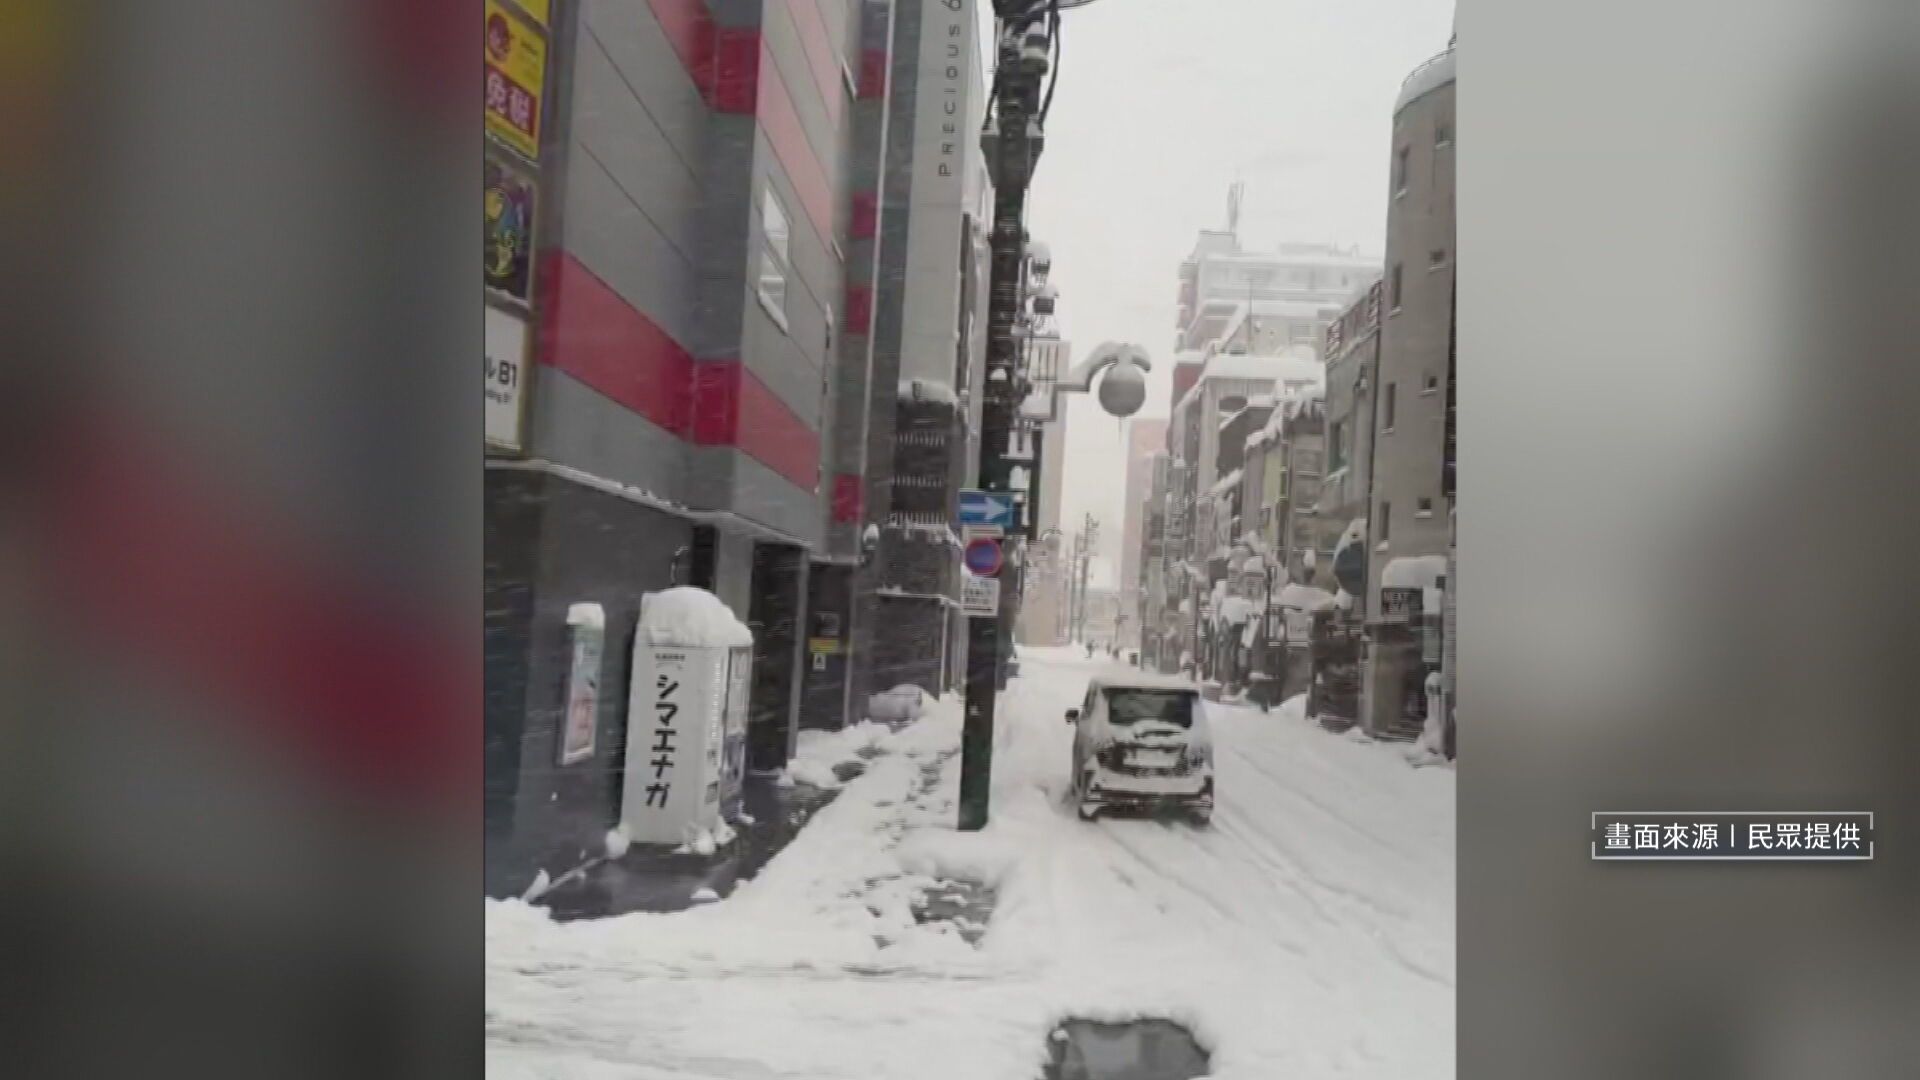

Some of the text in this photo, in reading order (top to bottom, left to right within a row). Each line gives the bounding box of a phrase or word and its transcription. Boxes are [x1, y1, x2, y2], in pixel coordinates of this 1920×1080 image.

[938, 24, 960, 177] PRECIOUS
[645, 674, 679, 808] シマエナガ
